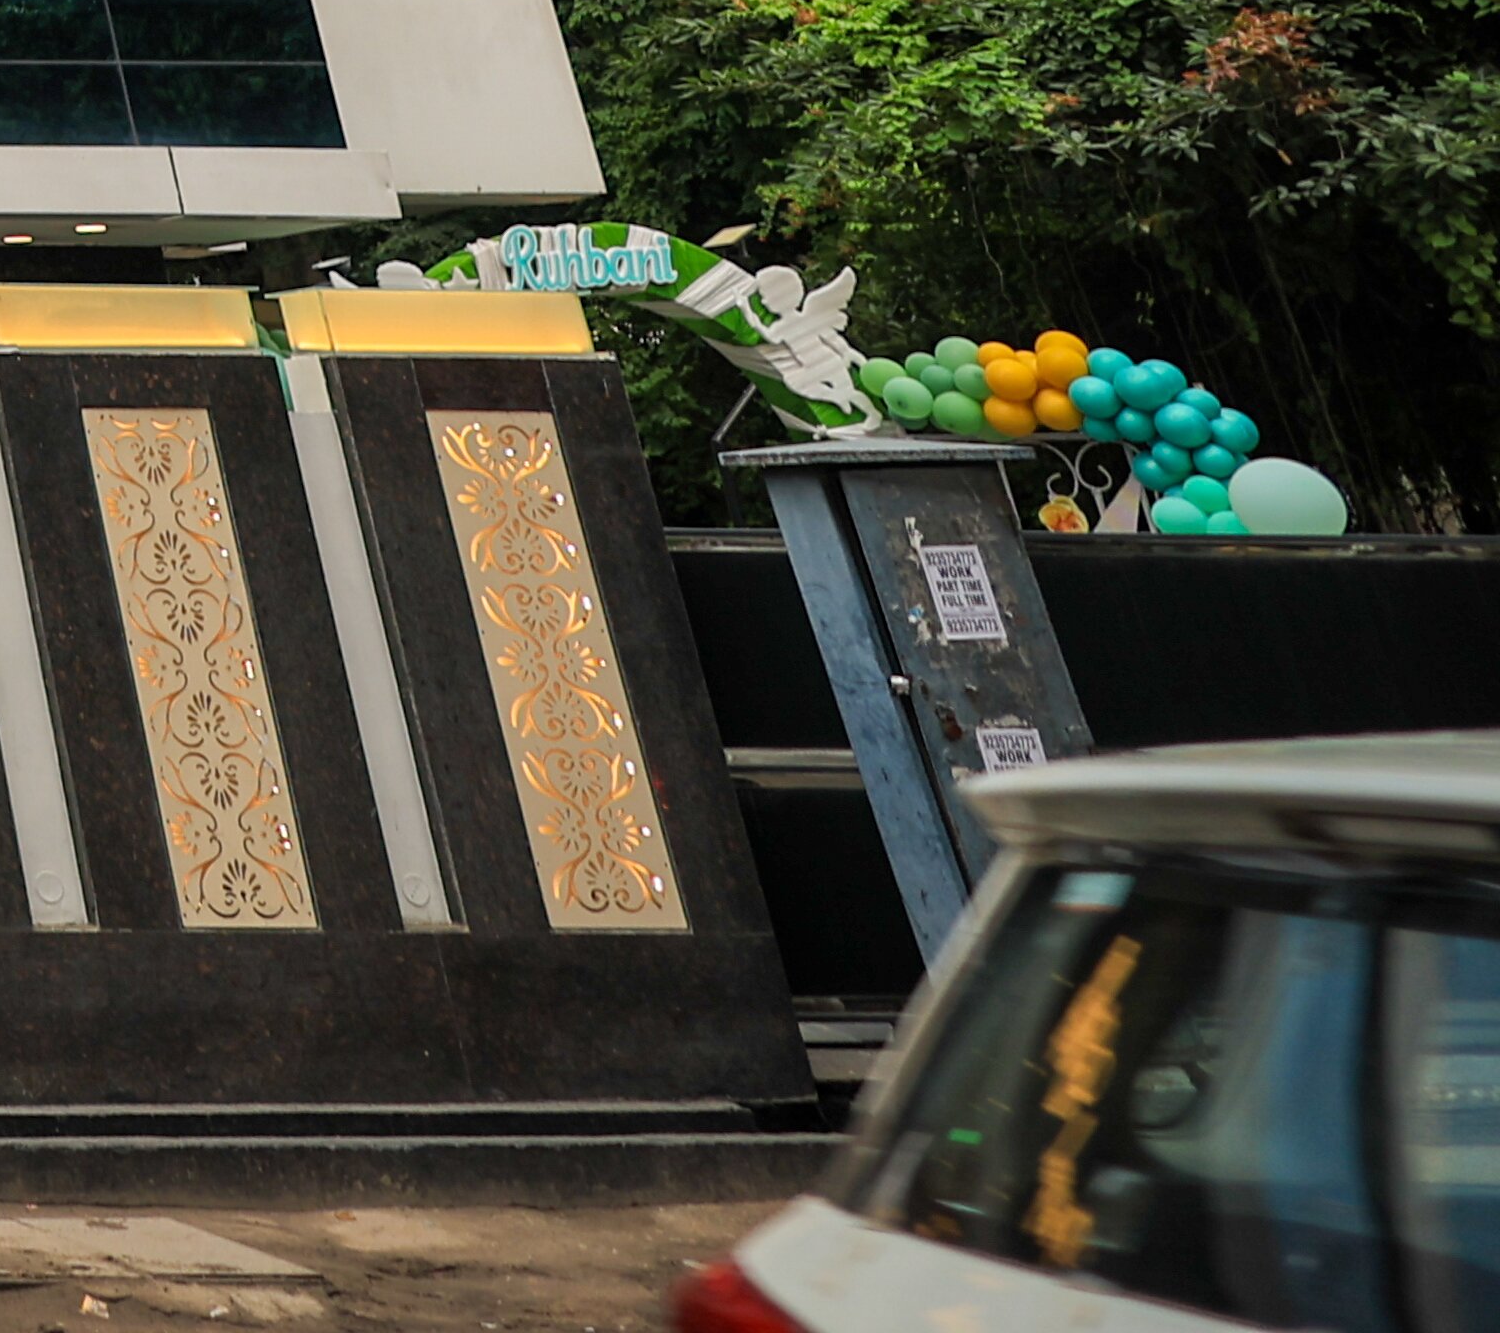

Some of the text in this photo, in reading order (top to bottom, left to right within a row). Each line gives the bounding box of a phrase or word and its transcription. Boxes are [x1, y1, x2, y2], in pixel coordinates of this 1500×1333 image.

[501, 224, 678, 291] Ruhbani
[937, 566, 973, 578] WORK
[936, 580, 984, 592] PART TIME
[941, 594, 988, 606] FULL TIME
[995, 749, 1033, 763] WORK
